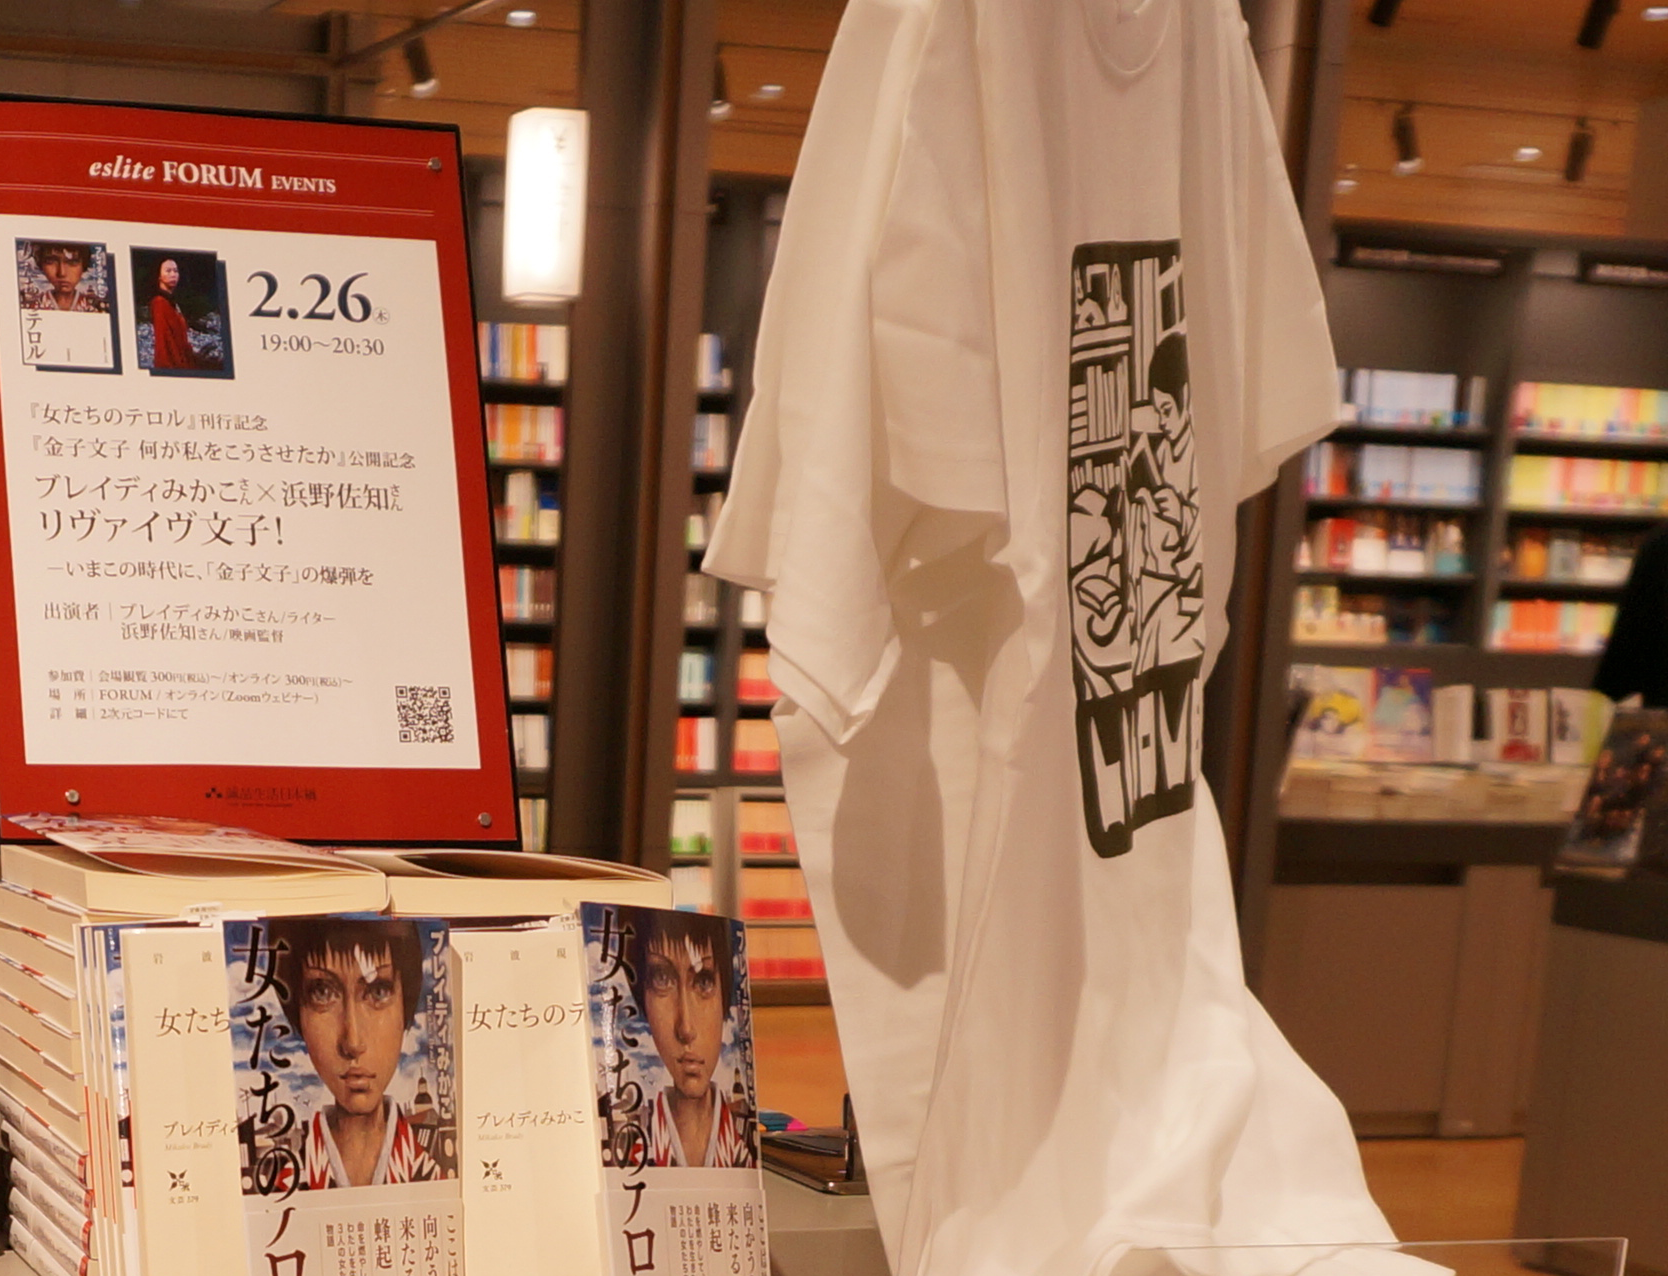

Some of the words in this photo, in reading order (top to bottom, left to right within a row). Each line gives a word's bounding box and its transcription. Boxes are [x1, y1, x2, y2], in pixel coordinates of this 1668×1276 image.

[89, 155, 156, 181] eslite
[163, 160, 264, 190] FORUM
[271, 174, 337, 195] EVENTS
[247, 270, 373, 324] 2.26
[30, 402, 269, 431] 『女たちのテロル』刊行記念
[32, 435, 130, 459] 『金子文子
[43, 601, 100, 621] 出演者
[48, 670, 85, 683] 参加費
[99, 689, 153, 701] FORUM
[429, 930, 454, 1121] ブレイディみかこ
[476, 1109, 586, 1129] ブレイディみかこ
[707, 1202, 723, 1253] 蜂起
[373, 1217, 393, 1270] 蜂起
